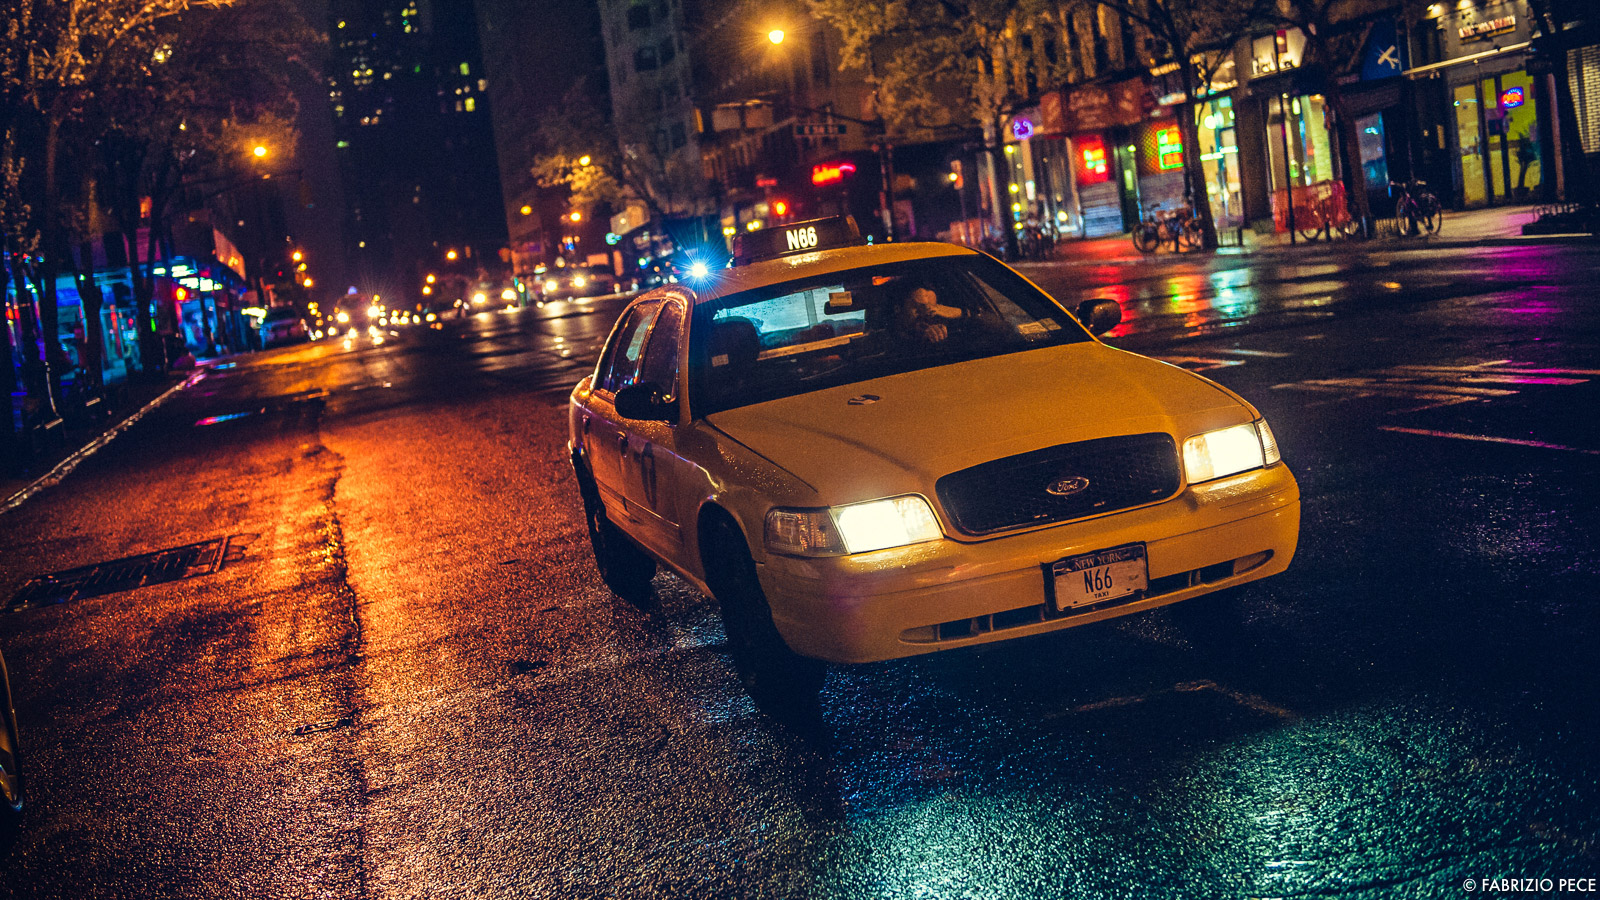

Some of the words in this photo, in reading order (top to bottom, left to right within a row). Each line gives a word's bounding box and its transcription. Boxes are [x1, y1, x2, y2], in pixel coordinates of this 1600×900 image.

[785, 226, 818, 250] N66
[1058, 480, 1078, 492] Ford
[1074, 558, 1096, 570] NEW
[1097, 553, 1122, 566] YORK
[1084, 567, 1112, 593] N66
